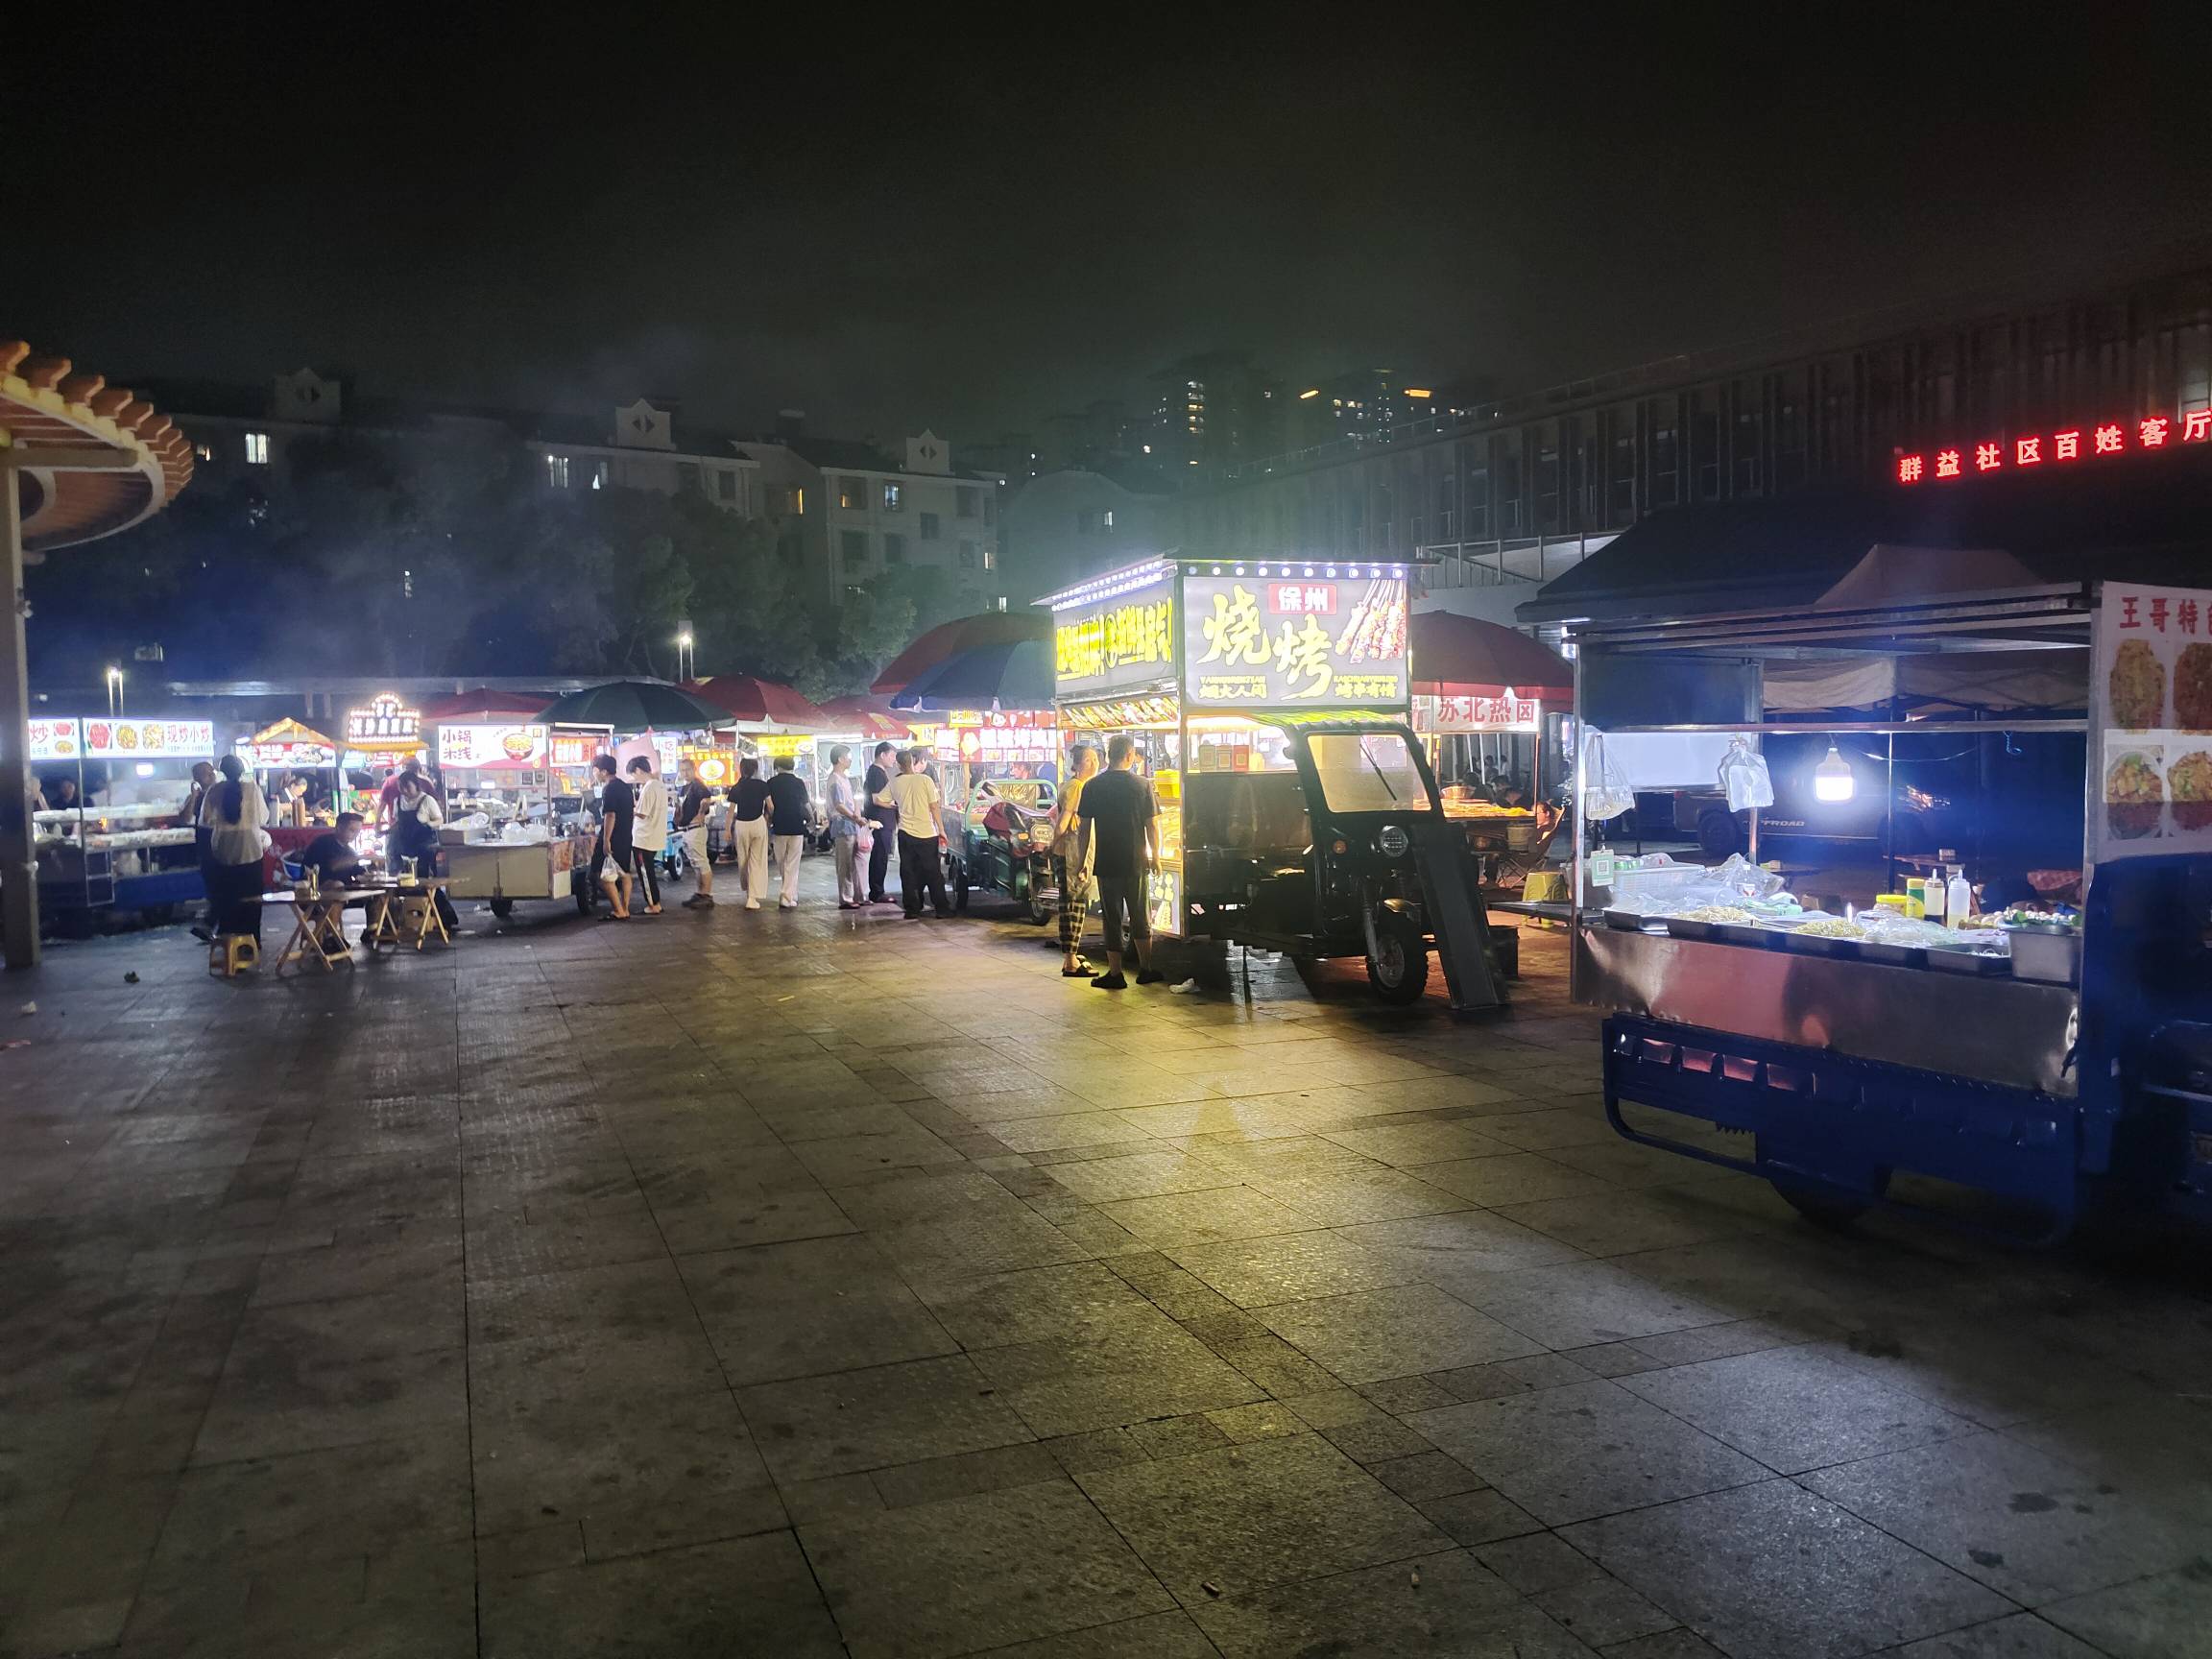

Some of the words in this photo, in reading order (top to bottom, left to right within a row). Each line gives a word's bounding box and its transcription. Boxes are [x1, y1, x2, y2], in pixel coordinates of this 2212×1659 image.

[1899, 411, 2212, 482] 群益社区百姓客厅
[1279, 587, 1328, 612] 徐州
[2119, 596, 2212, 635] 王哥特
[1197, 584, 1334, 701] 烧烤
[442, 729, 472, 744] 小锅
